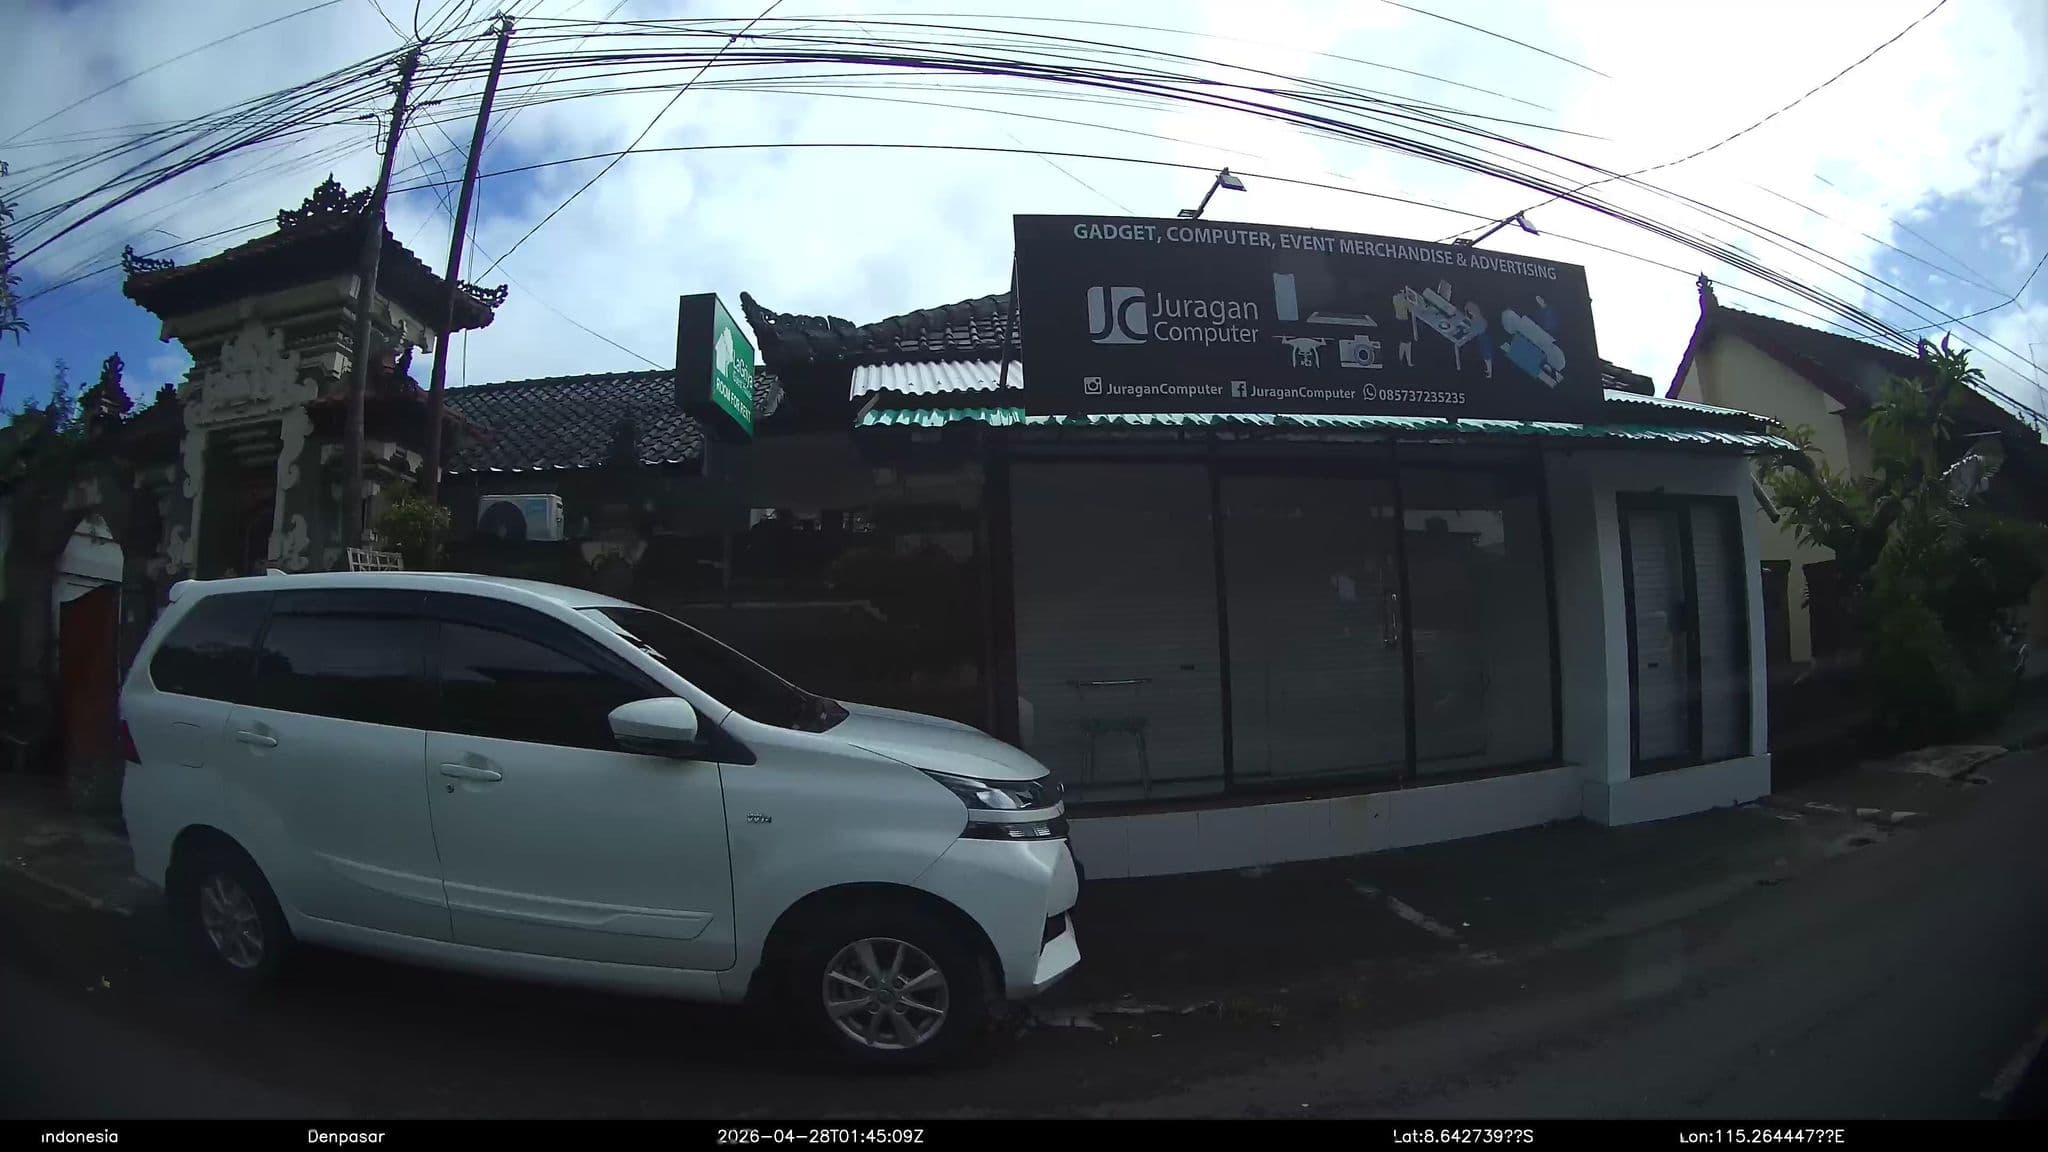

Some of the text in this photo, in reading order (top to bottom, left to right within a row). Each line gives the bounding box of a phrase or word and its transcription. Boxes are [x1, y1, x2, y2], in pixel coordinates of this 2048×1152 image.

[1073, 223, 1557, 280] GADGET, COMPUTER, EVENT MERCHANDISE & ADVERTISING
[1152, 293, 1259, 325] Juragan
[1154, 321, 1259, 346] Computer
[716, 377, 731, 402] ROOM
[730, 391, 741, 411] FOR
[739, 399, 751, 423] RENT
[1106, 383, 1223, 397] JuraganComputer
[1250, 385, 1356, 400] JuraganComputer
[1379, 389, 1466, 404] 085737235235
